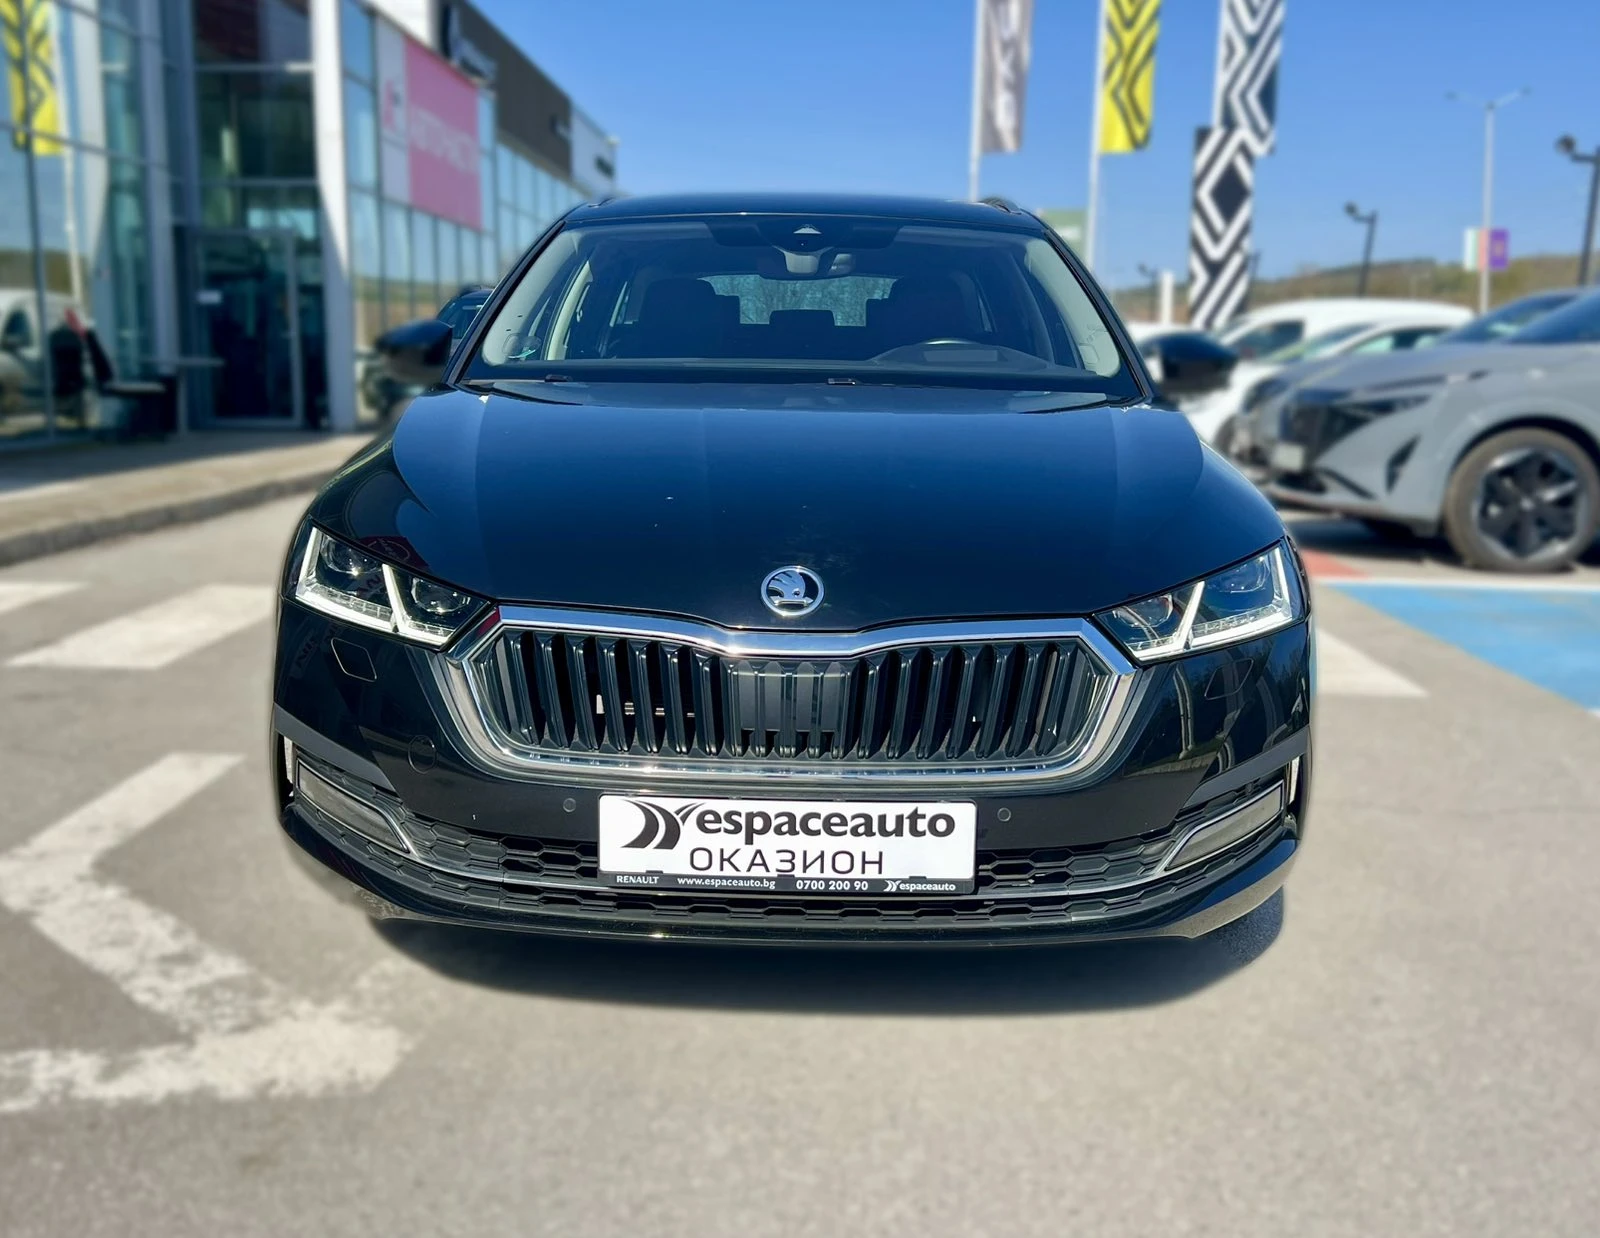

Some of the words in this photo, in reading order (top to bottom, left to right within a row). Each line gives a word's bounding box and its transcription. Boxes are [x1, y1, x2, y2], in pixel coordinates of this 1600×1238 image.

[695, 806, 956, 845] espaceauto
[689, 847, 883, 875] ОКАЗИОН
[616, 875, 660, 884] RENAULT
[677, 876, 776, 890] www.espaceauto.bg
[796, 879, 825, 890] 0700
[828, 880, 850, 890] 200
[853, 880, 869, 891] 90
[899, 882, 957, 892] espaceauto
